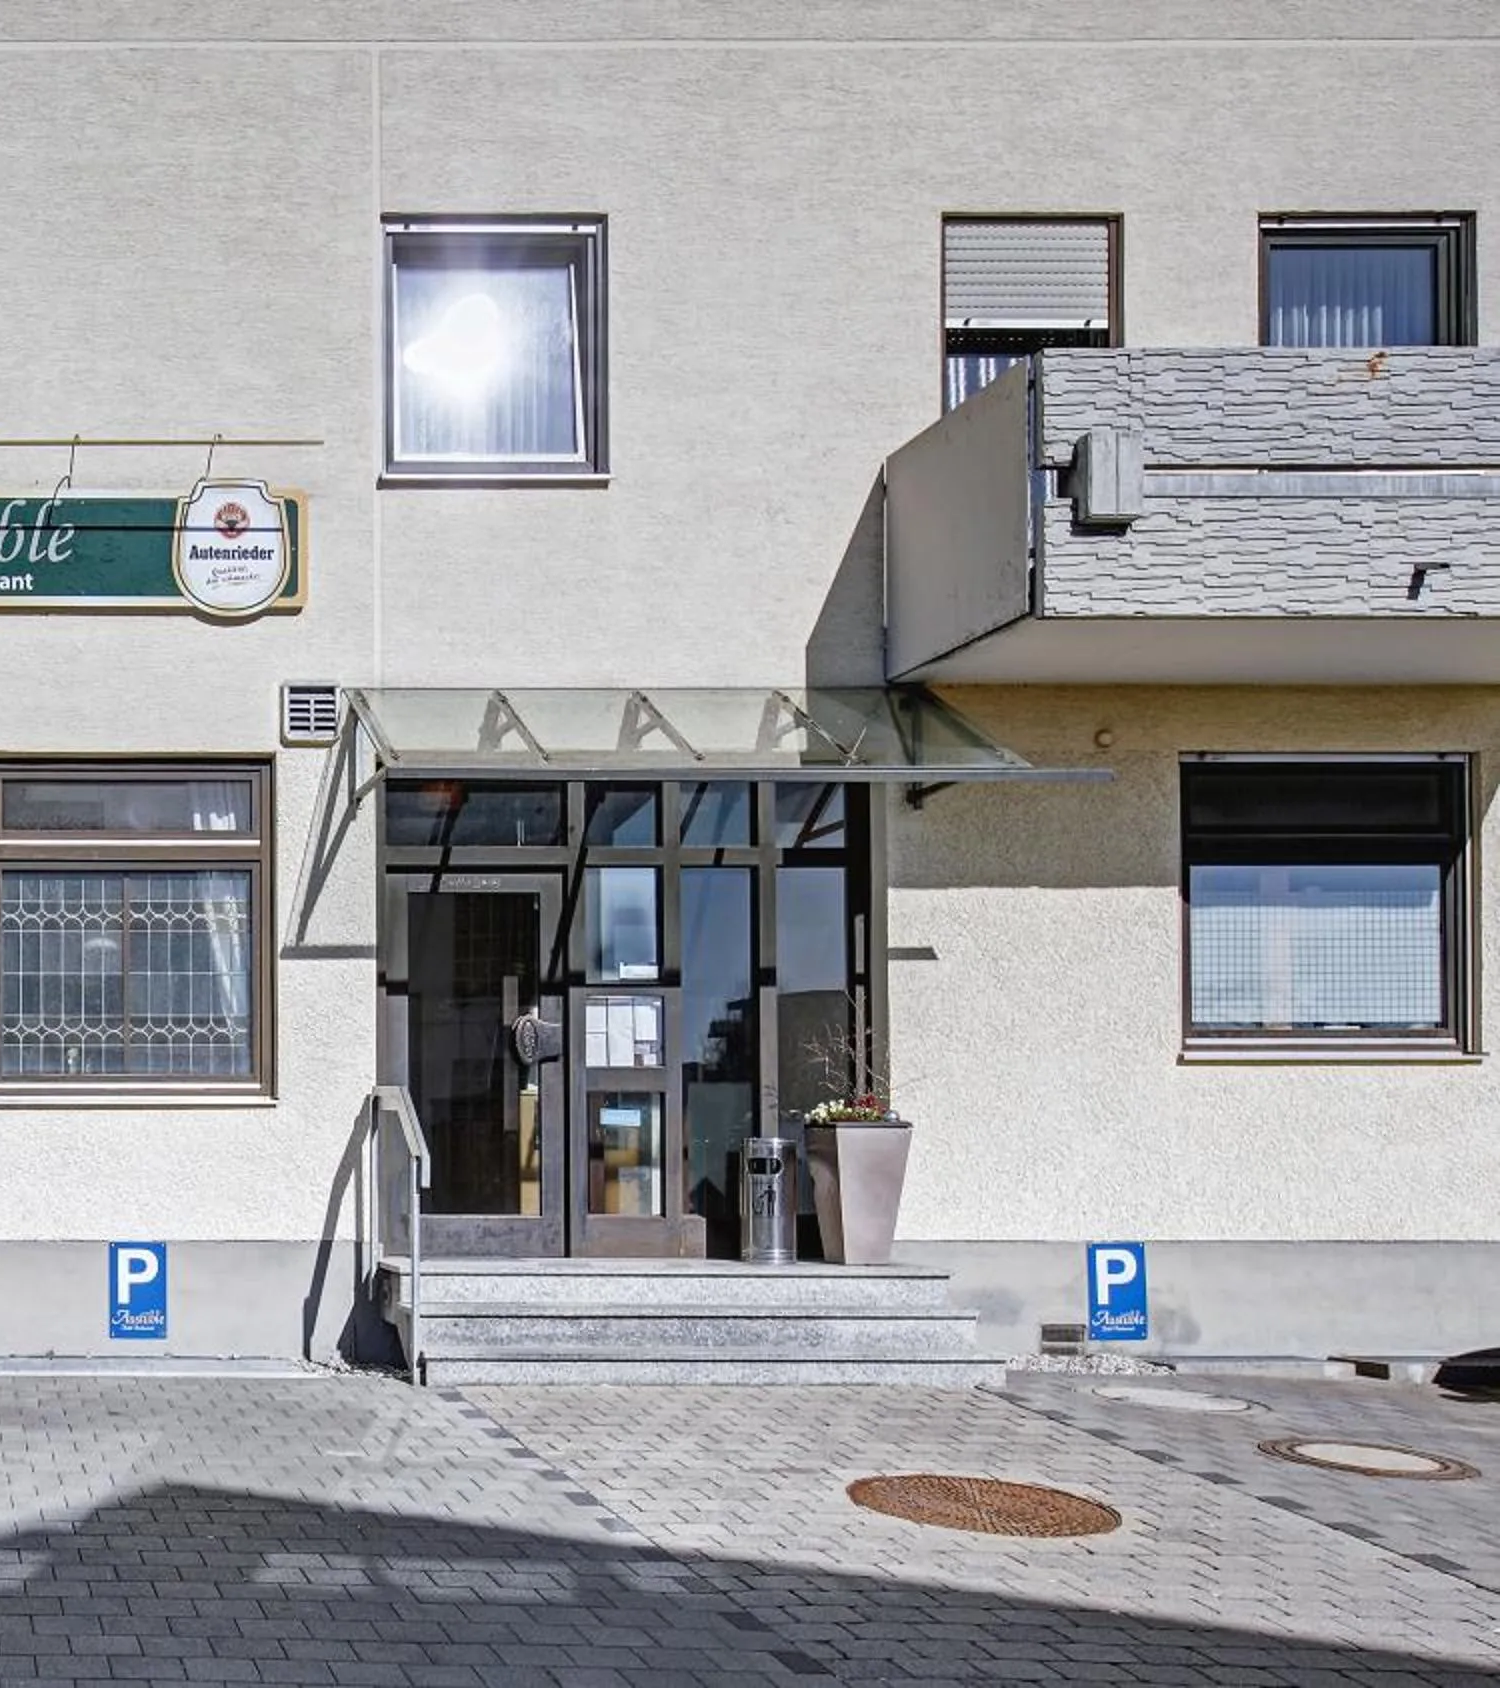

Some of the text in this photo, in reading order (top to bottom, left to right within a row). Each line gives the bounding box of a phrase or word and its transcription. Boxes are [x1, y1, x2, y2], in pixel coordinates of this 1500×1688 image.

[189, 545, 275, 560] Autenrieder
[117, 1247, 159, 1305] P
[1095, 1249, 1137, 1305] P
